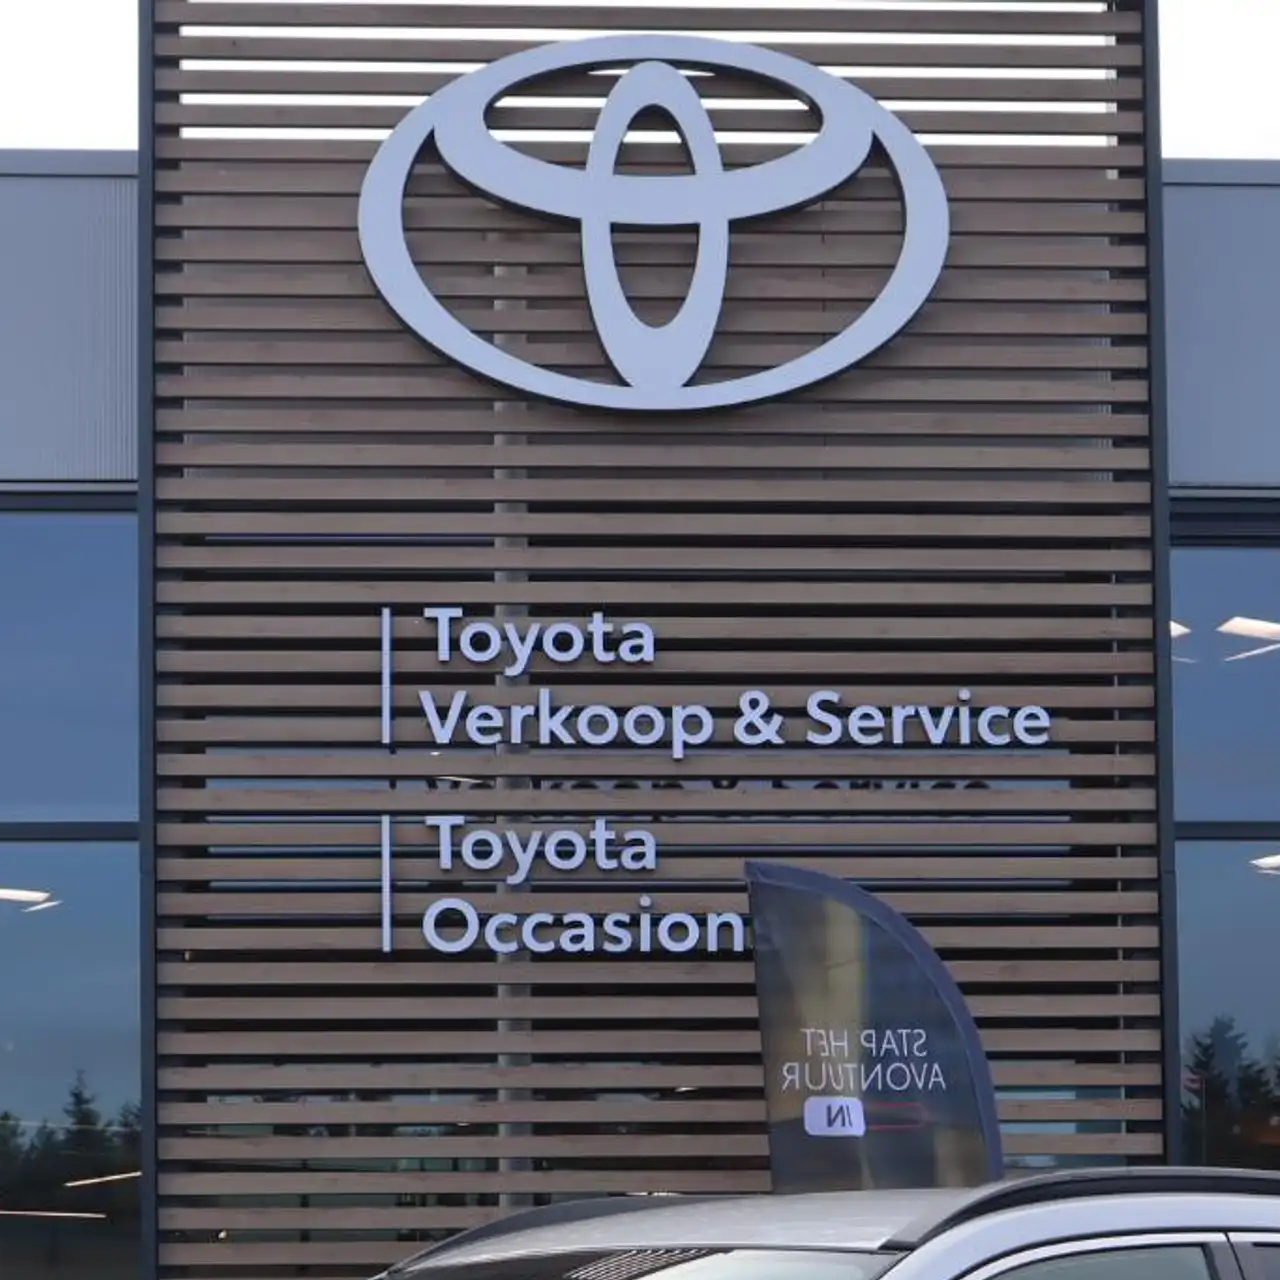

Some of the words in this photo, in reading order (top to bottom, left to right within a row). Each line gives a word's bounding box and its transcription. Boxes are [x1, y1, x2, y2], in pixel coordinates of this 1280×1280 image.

[423, 607, 656, 677] Toyota
[420, 688, 715, 760] Verkoop
[733, 689, 784, 746] &
[806, 688, 1051, 746] Service
[424, 815, 658, 884] Toyota
[422, 896, 746, 954] Occasion
